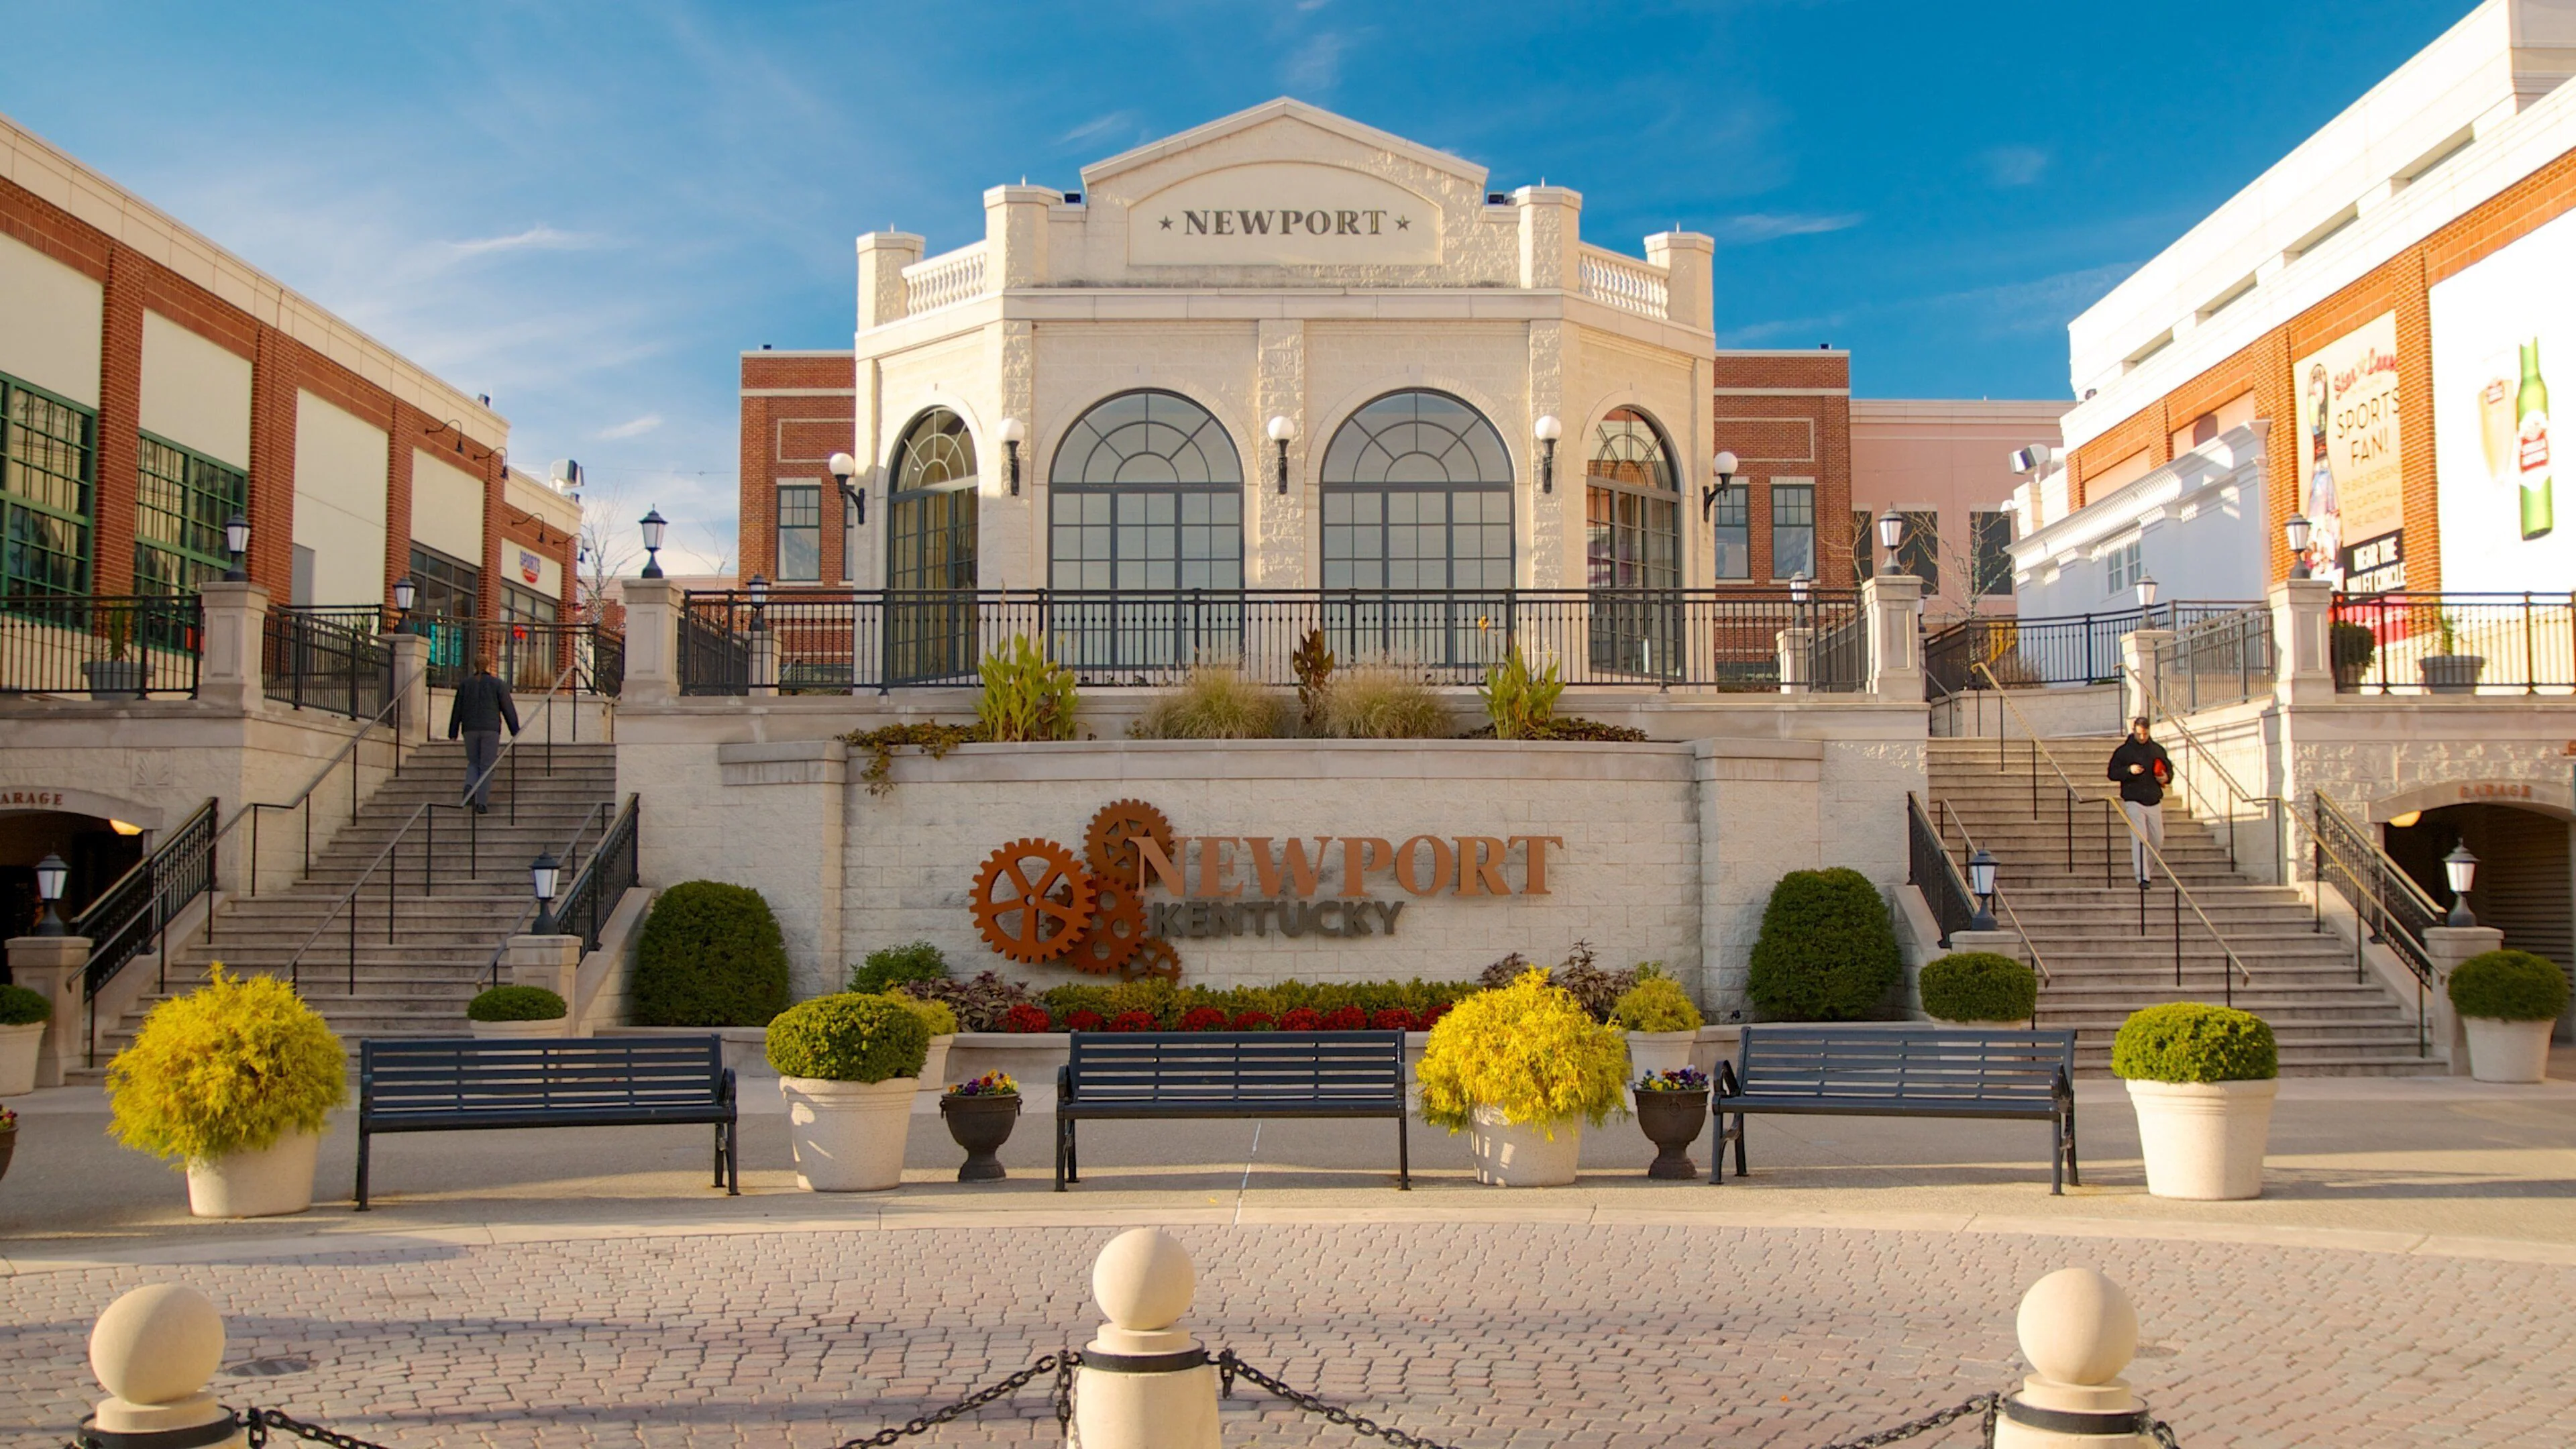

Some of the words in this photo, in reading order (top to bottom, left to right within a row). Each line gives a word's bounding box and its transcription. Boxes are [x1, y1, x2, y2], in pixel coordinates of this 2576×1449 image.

[1184, 210, 1387, 235] NEWPORT
[2337, 387, 2400, 439] SPORTS
[2351, 427, 2388, 468] FAN!
[520, 551, 541, 574] SPORTS
[2354, 543, 2379, 572] NEAR
[2378, 537, 2398, 562] THE
[2374, 561, 2407, 592] CIRCLE
[2460, 784, 2532, 798] GARAGE
[1128, 835, 1564, 896] NEWPORT
[1150, 901, 1405, 936] KENTUCKY
